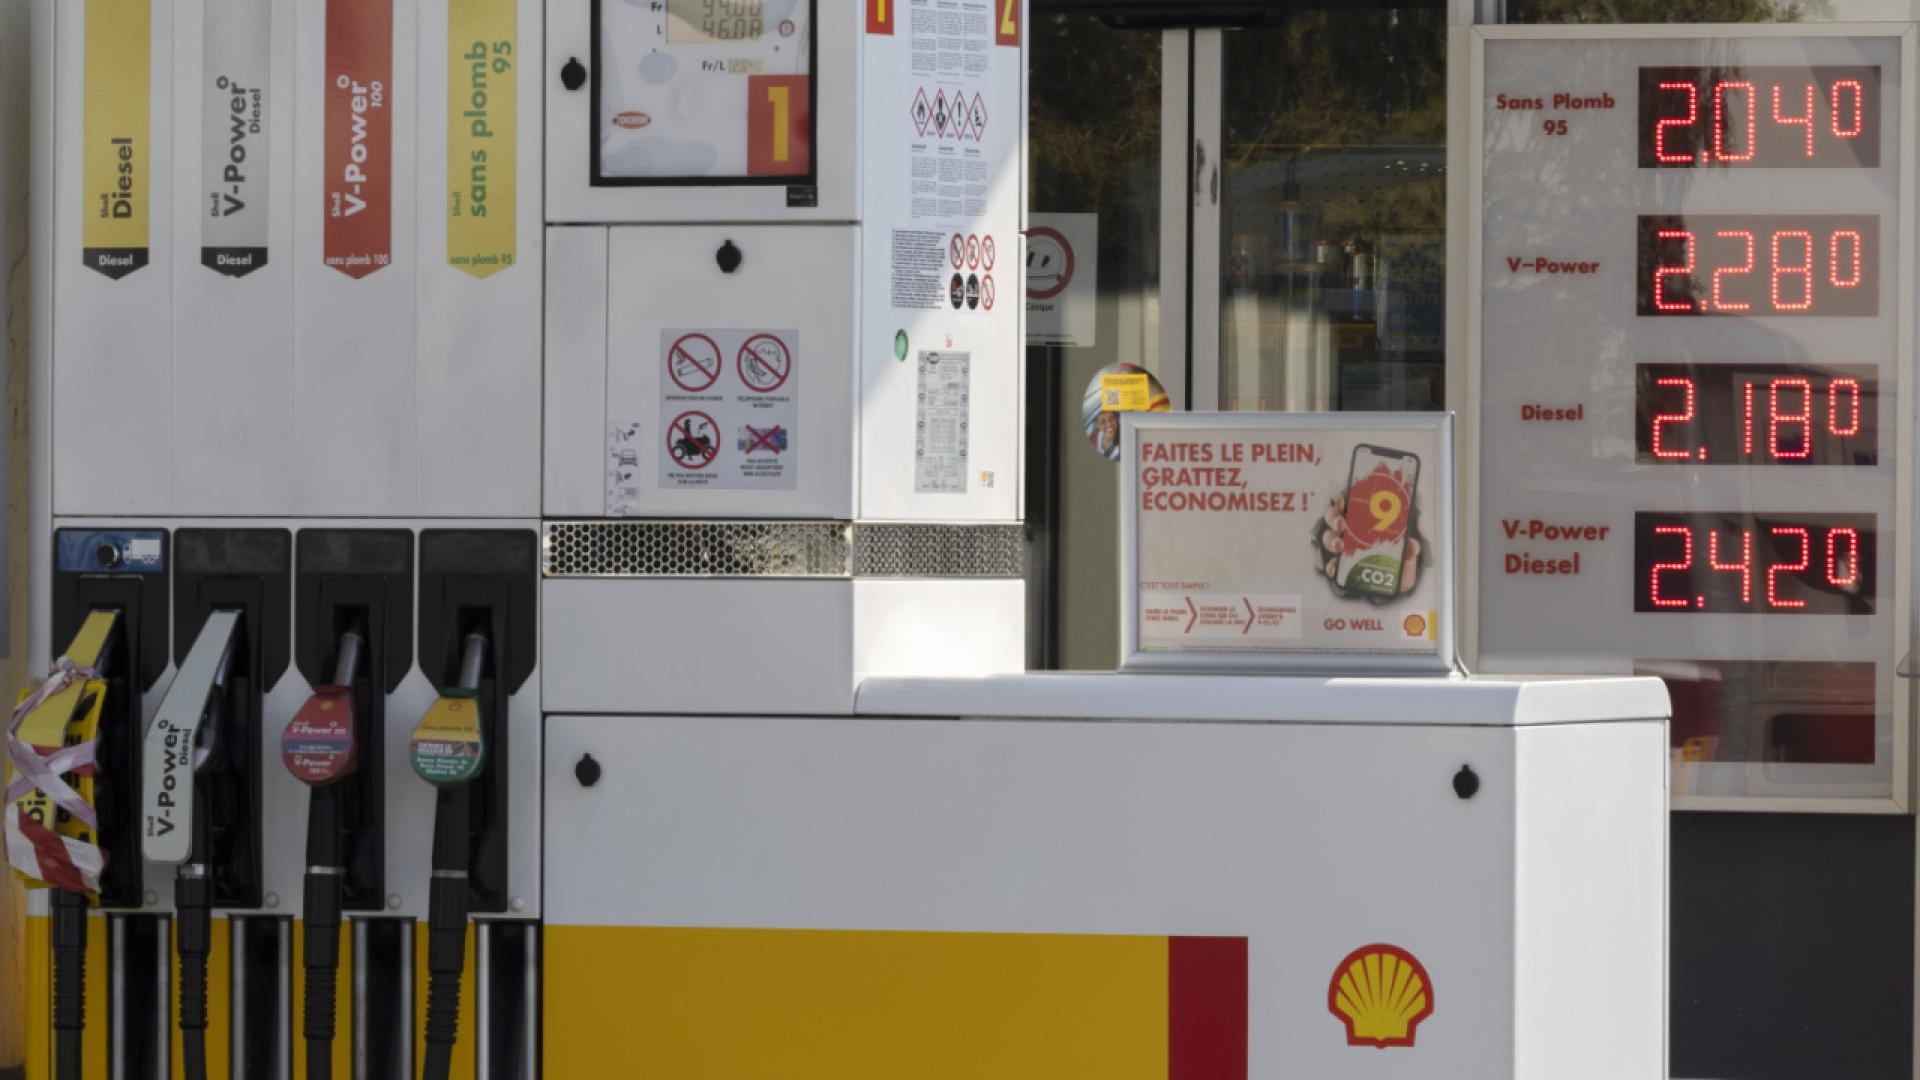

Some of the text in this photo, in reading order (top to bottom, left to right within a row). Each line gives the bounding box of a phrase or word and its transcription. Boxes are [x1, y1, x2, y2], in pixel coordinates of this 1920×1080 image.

[651, 2, 663, 12] Fr
[657, 24, 663, 35] L
[493, 40, 513, 74] 95
[702, 60, 725, 71] Fr/L
[371, 81, 383, 107] 100
[1496, 93, 1615, 111] Sans Plomb
[249, 88, 261, 134] Diesel
[463, 41, 493, 217] sans plomb
[768, 86, 789, 161] 1
[1543, 120, 1568, 136] 95
[223, 82, 246, 216] V-Power
[345, 81, 368, 217] V-Power
[112, 137, 133, 219] Diesel
[99, 254, 133, 266] Diesel
[217, 254, 252, 266] Diesel
[327, 254, 389, 268] sans plomb 100
[451, 254, 513, 268] sans plomb 95
[1520, 404, 1584, 421] Diesel
[1142, 443, 1322, 465] FAITES LE PLEIN,
[1142, 467, 1248, 489] GRATTEZ,
[1369, 490, 1402, 531] 9
[1502, 520, 1610, 541] V-Power
[1504, 553, 1580, 574] Diesel
[1361, 568, 1394, 586] CO2
[1324, 618, 1384, 631] GO WELL
[180, 729, 192, 765] Diesel
[158, 724, 180, 837] V-Power
